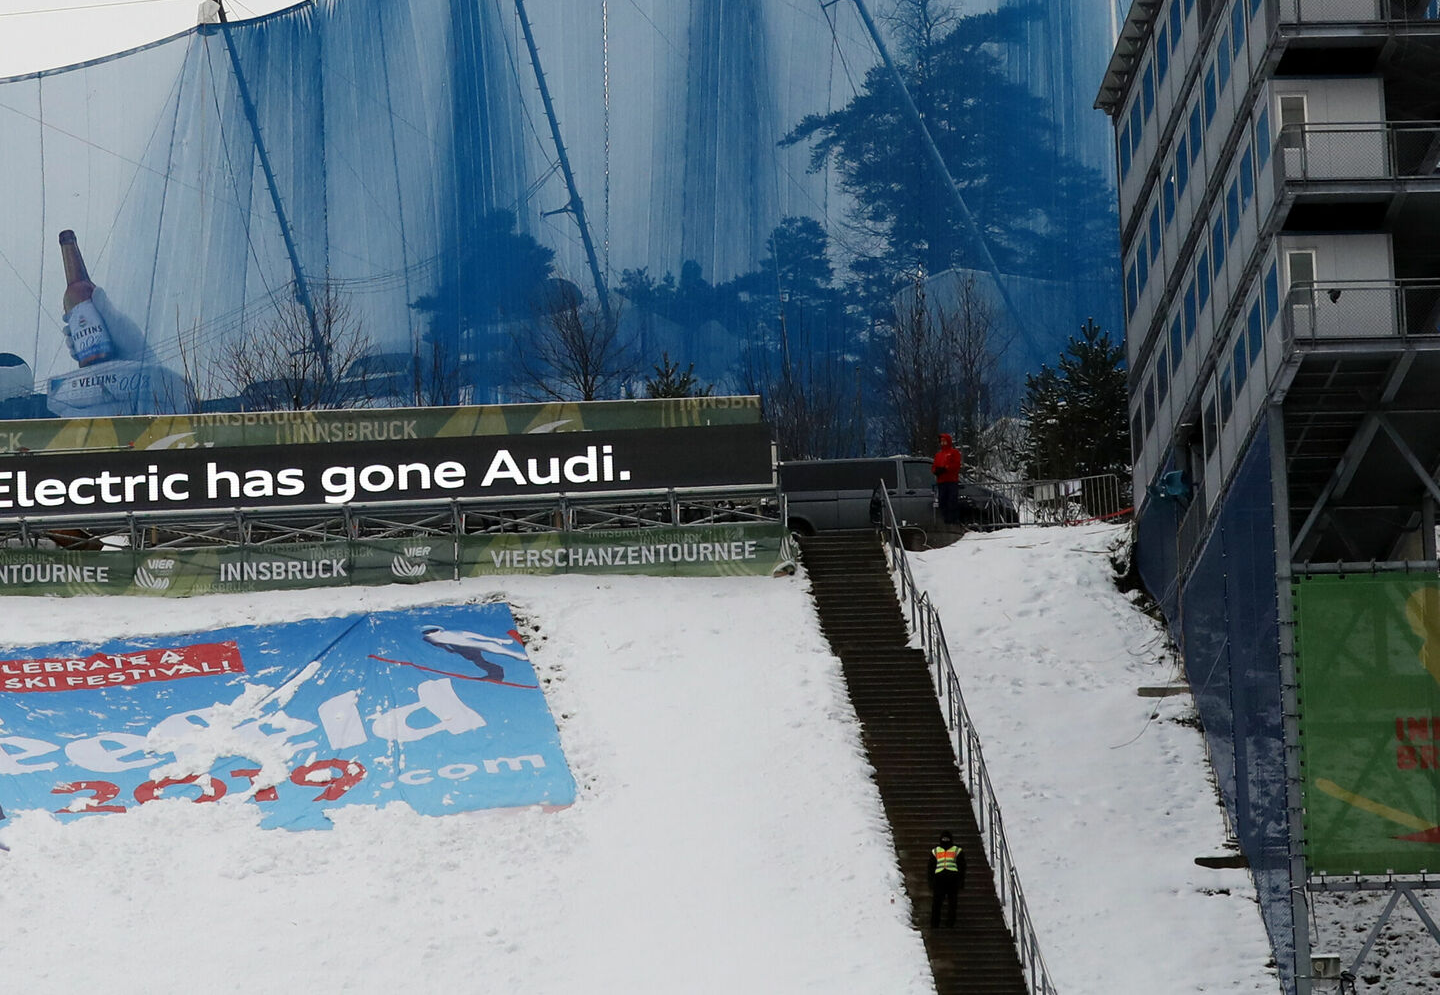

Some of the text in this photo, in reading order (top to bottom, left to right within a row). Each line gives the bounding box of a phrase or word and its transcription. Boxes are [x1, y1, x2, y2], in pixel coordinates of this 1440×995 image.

[79, 373, 117, 388] VELTINS
[292, 420, 418, 443] INNSBRUCK
[206, 462, 305, 499] has
[321, 460, 466, 504] gone
[481, 445, 631, 487] Audi.
[403, 546, 432, 557] VIER
[490, 540, 757, 568] VIERSCHANZENTOURNEE
[147, 559, 175, 570] VIER
[220, 558, 347, 581] INNSBRUCK
[4, 676, 56, 690] SKI
[66, 660, 232, 687] FESTIVAL!
[51, 758, 367, 814] 2019
